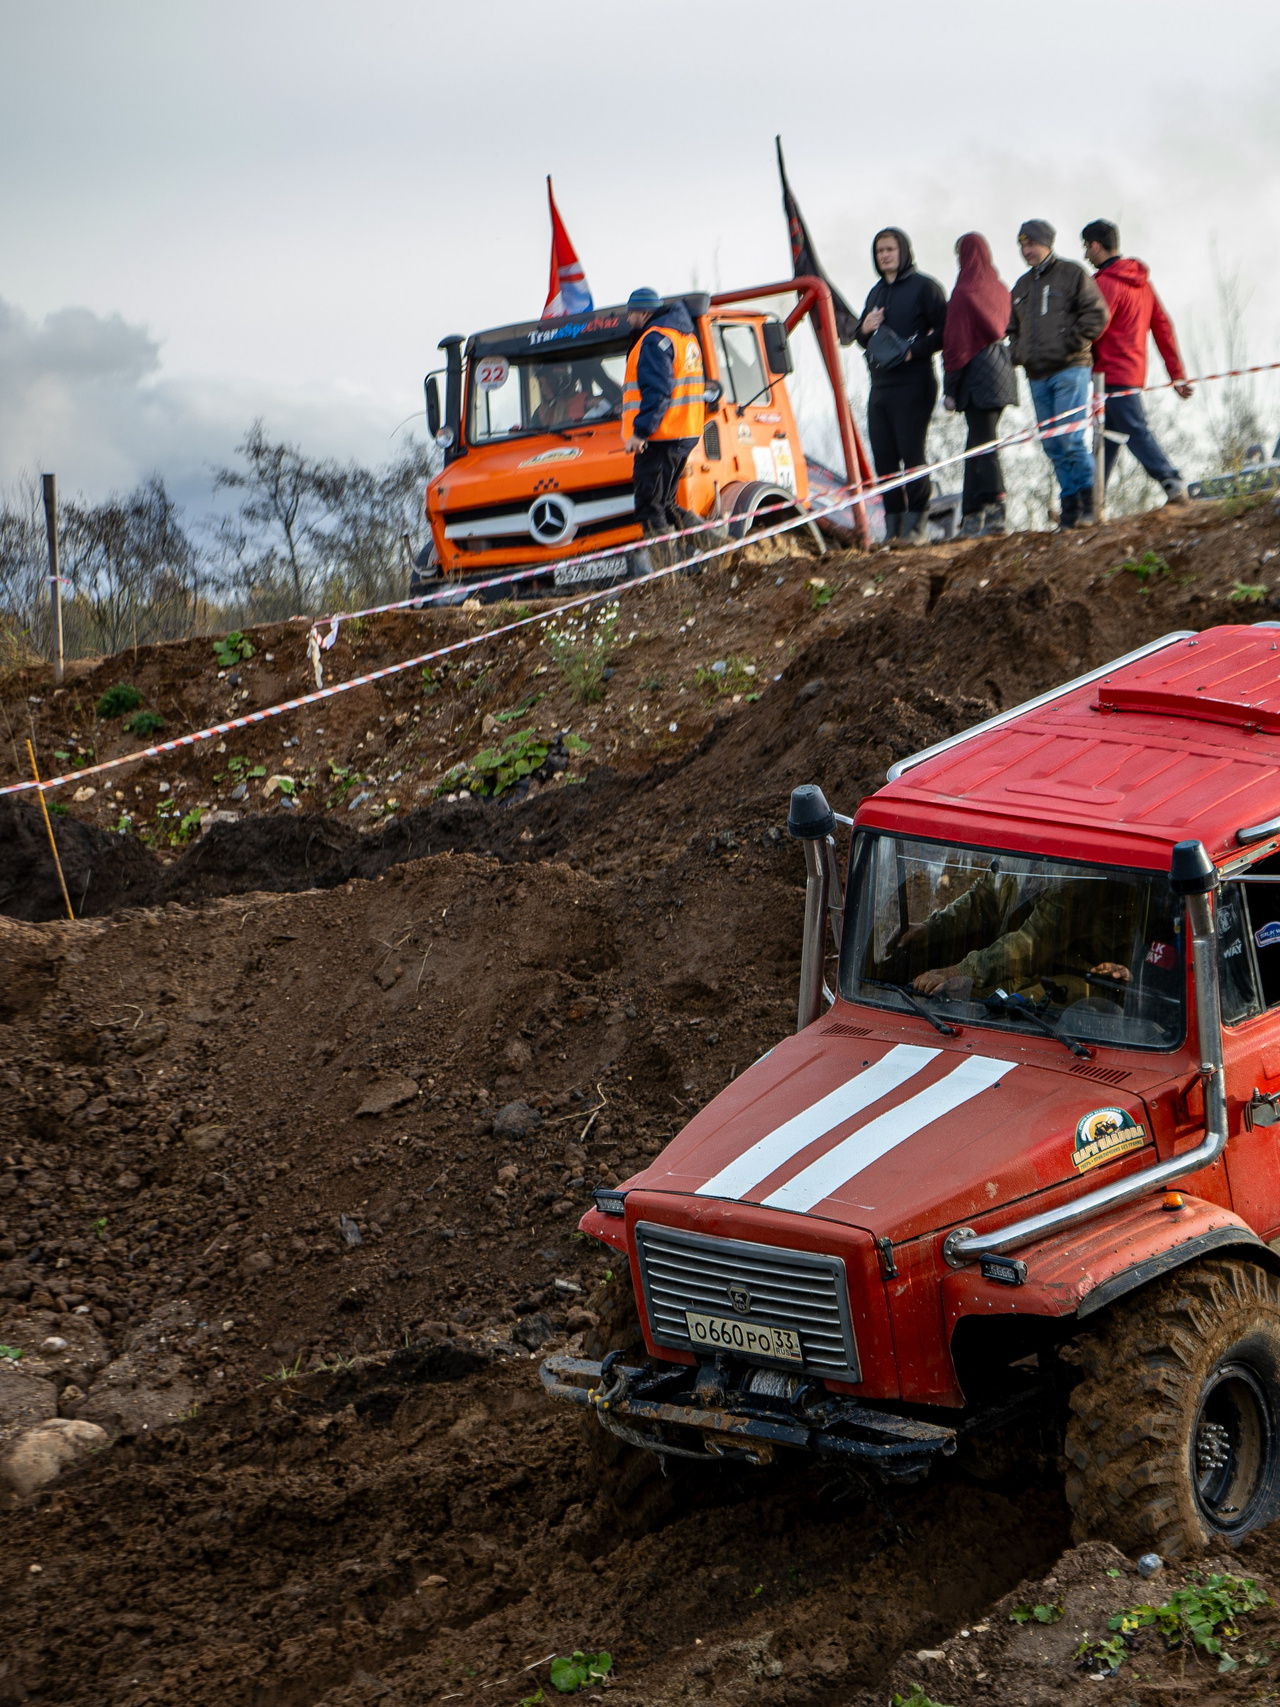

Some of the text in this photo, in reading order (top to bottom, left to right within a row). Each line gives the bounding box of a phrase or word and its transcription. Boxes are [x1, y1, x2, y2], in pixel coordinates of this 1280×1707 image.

[528, 317, 620, 346] TransSpecNaz
[481, 366, 504, 384] 22
[1223, 944, 1243, 959] WAY
[1073, 1125, 1145, 1165] ПАРК ПАВЛОВА
[773, 1330, 793, 1349] 33
[775, 1347, 791, 1356] RUS
